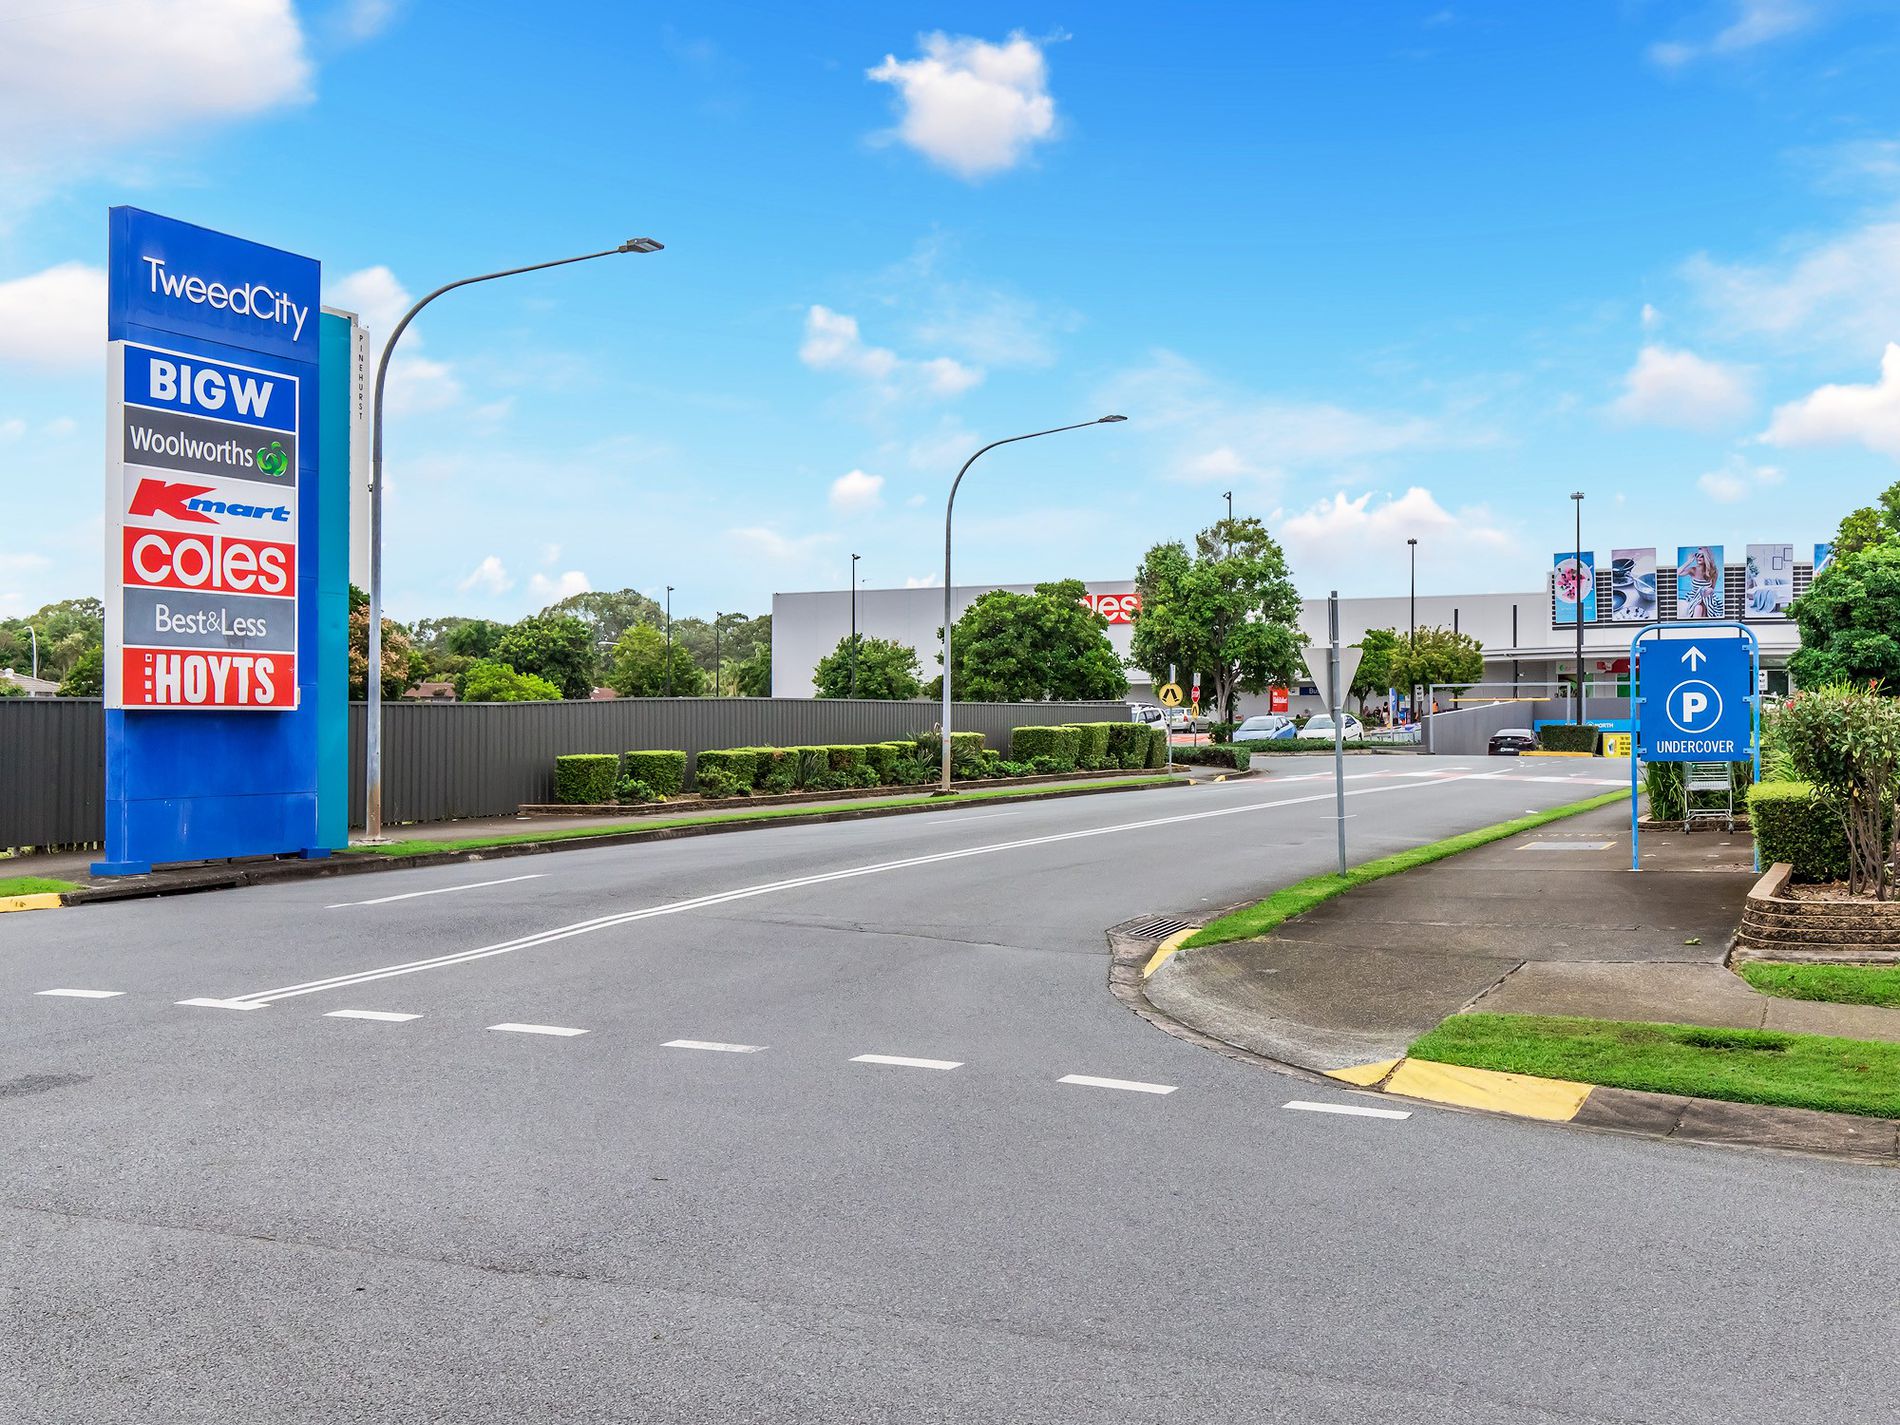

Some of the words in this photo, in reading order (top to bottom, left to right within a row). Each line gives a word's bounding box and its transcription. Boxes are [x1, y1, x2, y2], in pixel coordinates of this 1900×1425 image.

[142, 256, 308, 342] TweedCity
[130, 425, 254, 467] Woolworths
[128, 478, 291, 525] Kmart
[131, 534, 287, 593] coles
[155, 653, 275, 704] HOYTS
[1682, 692, 1708, 723] P
[1656, 740, 1734, 753] UNDERCOVER
